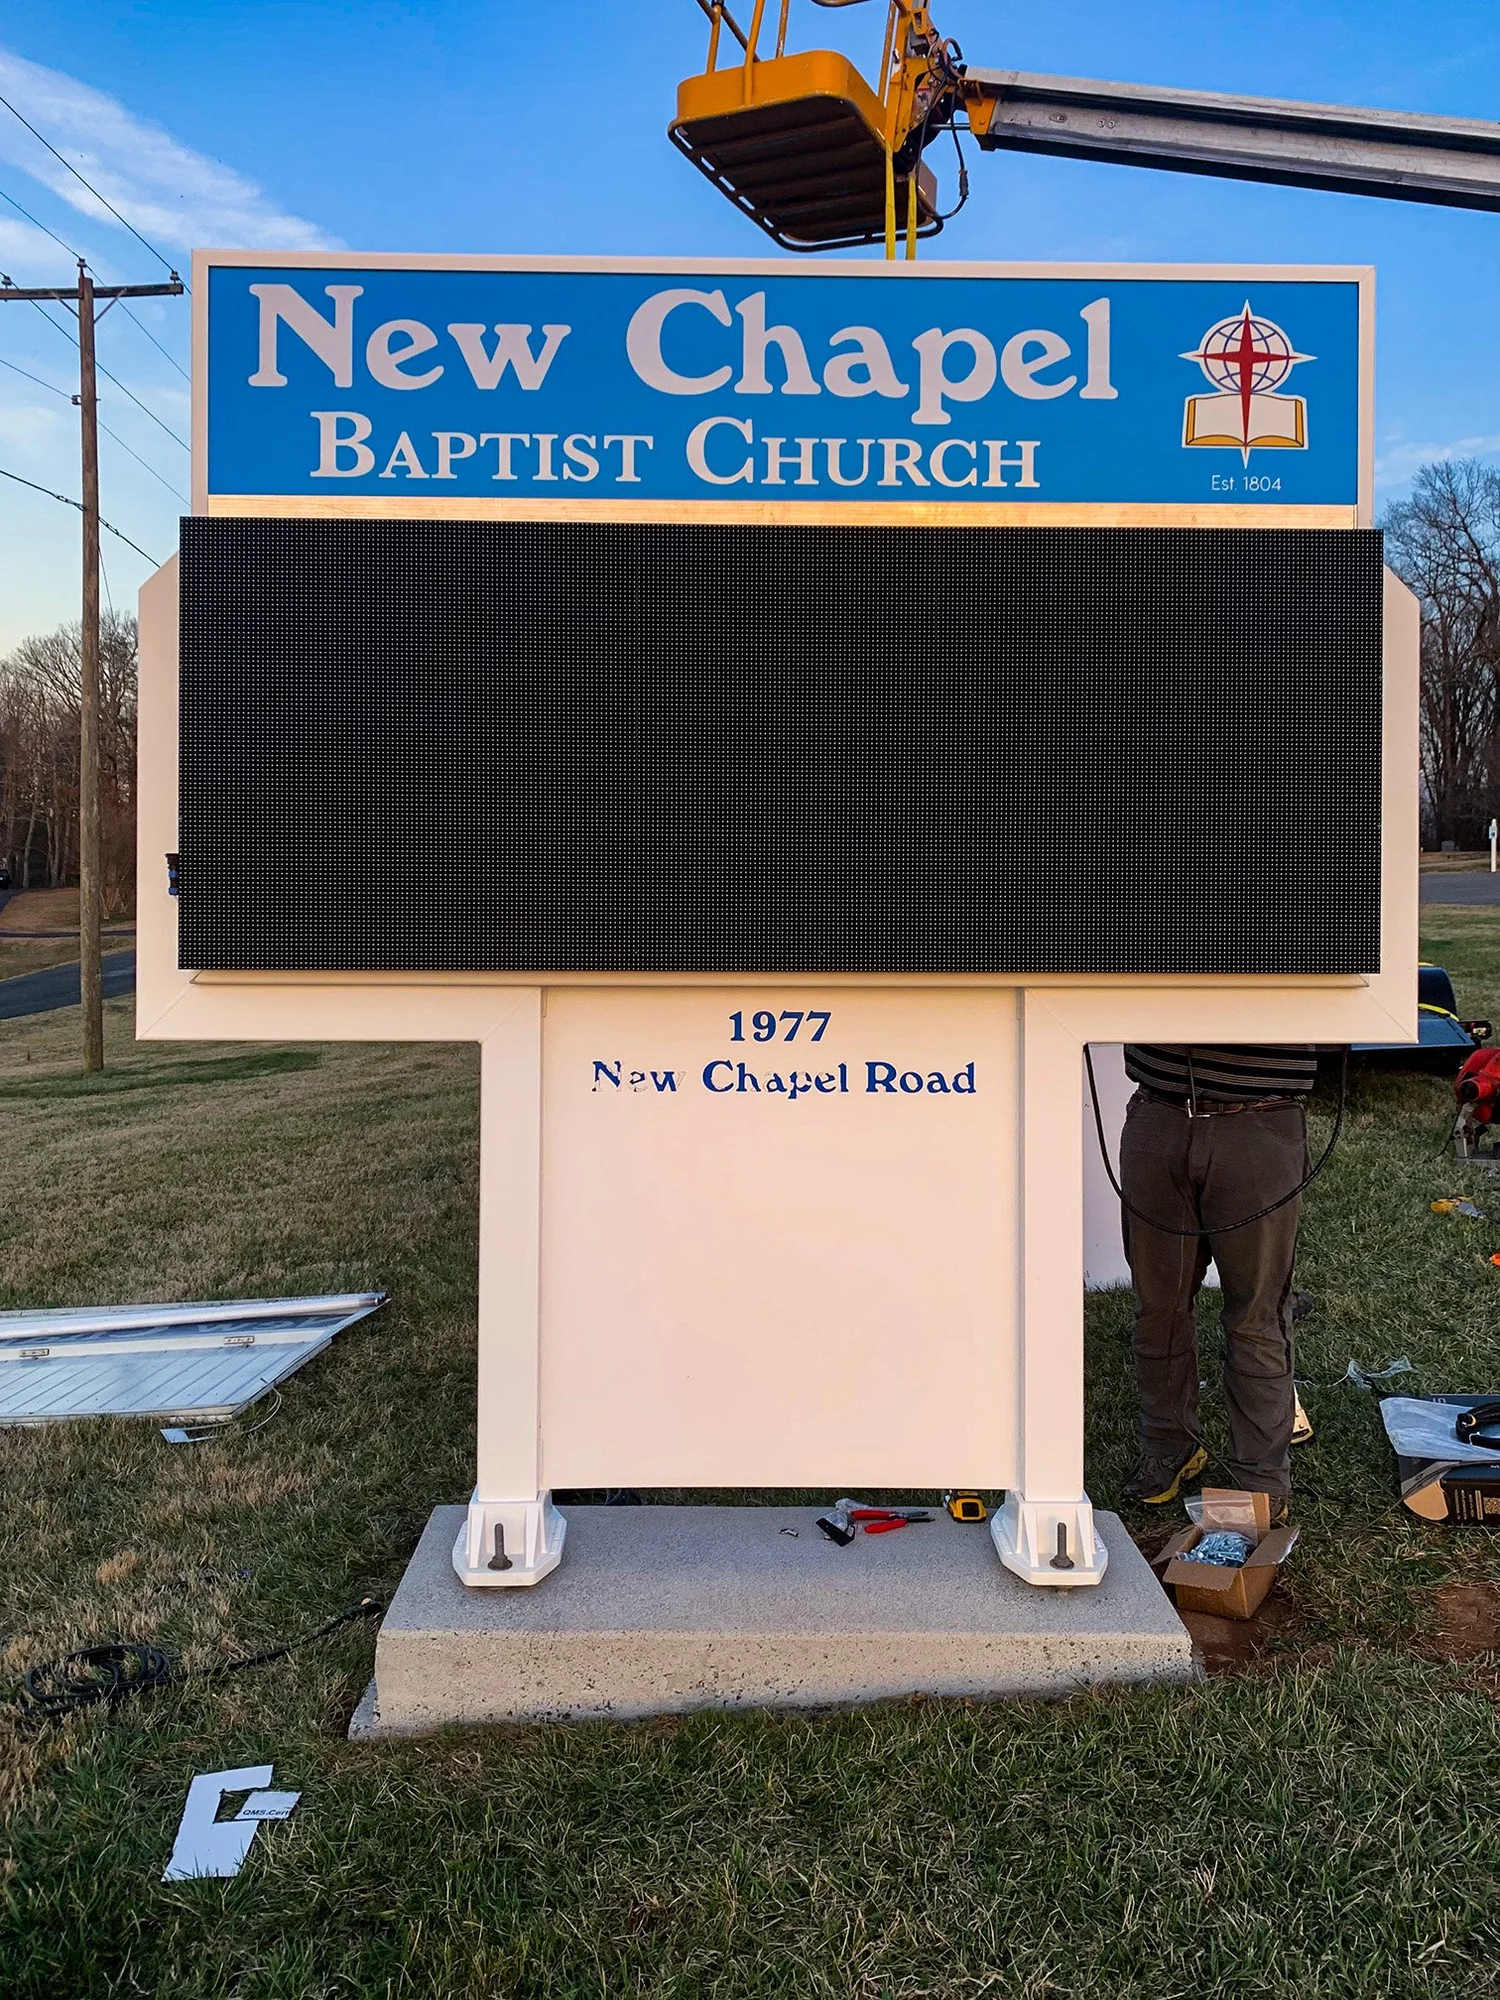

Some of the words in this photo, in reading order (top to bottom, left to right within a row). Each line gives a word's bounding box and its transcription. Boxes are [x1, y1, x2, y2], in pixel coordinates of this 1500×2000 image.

[248, 283, 572, 391] New
[625, 287, 1118, 425] Chapel
[310, 410, 654, 482] BAPTIST
[685, 416, 1041, 488] CHURCH
[1211, 474, 1237, 491] Est.
[1243, 475, 1281, 491] 1804
[729, 1010, 831, 1042] 1977
[702, 1059, 849, 1100] Chapel
[865, 1061, 976, 1094] Road
